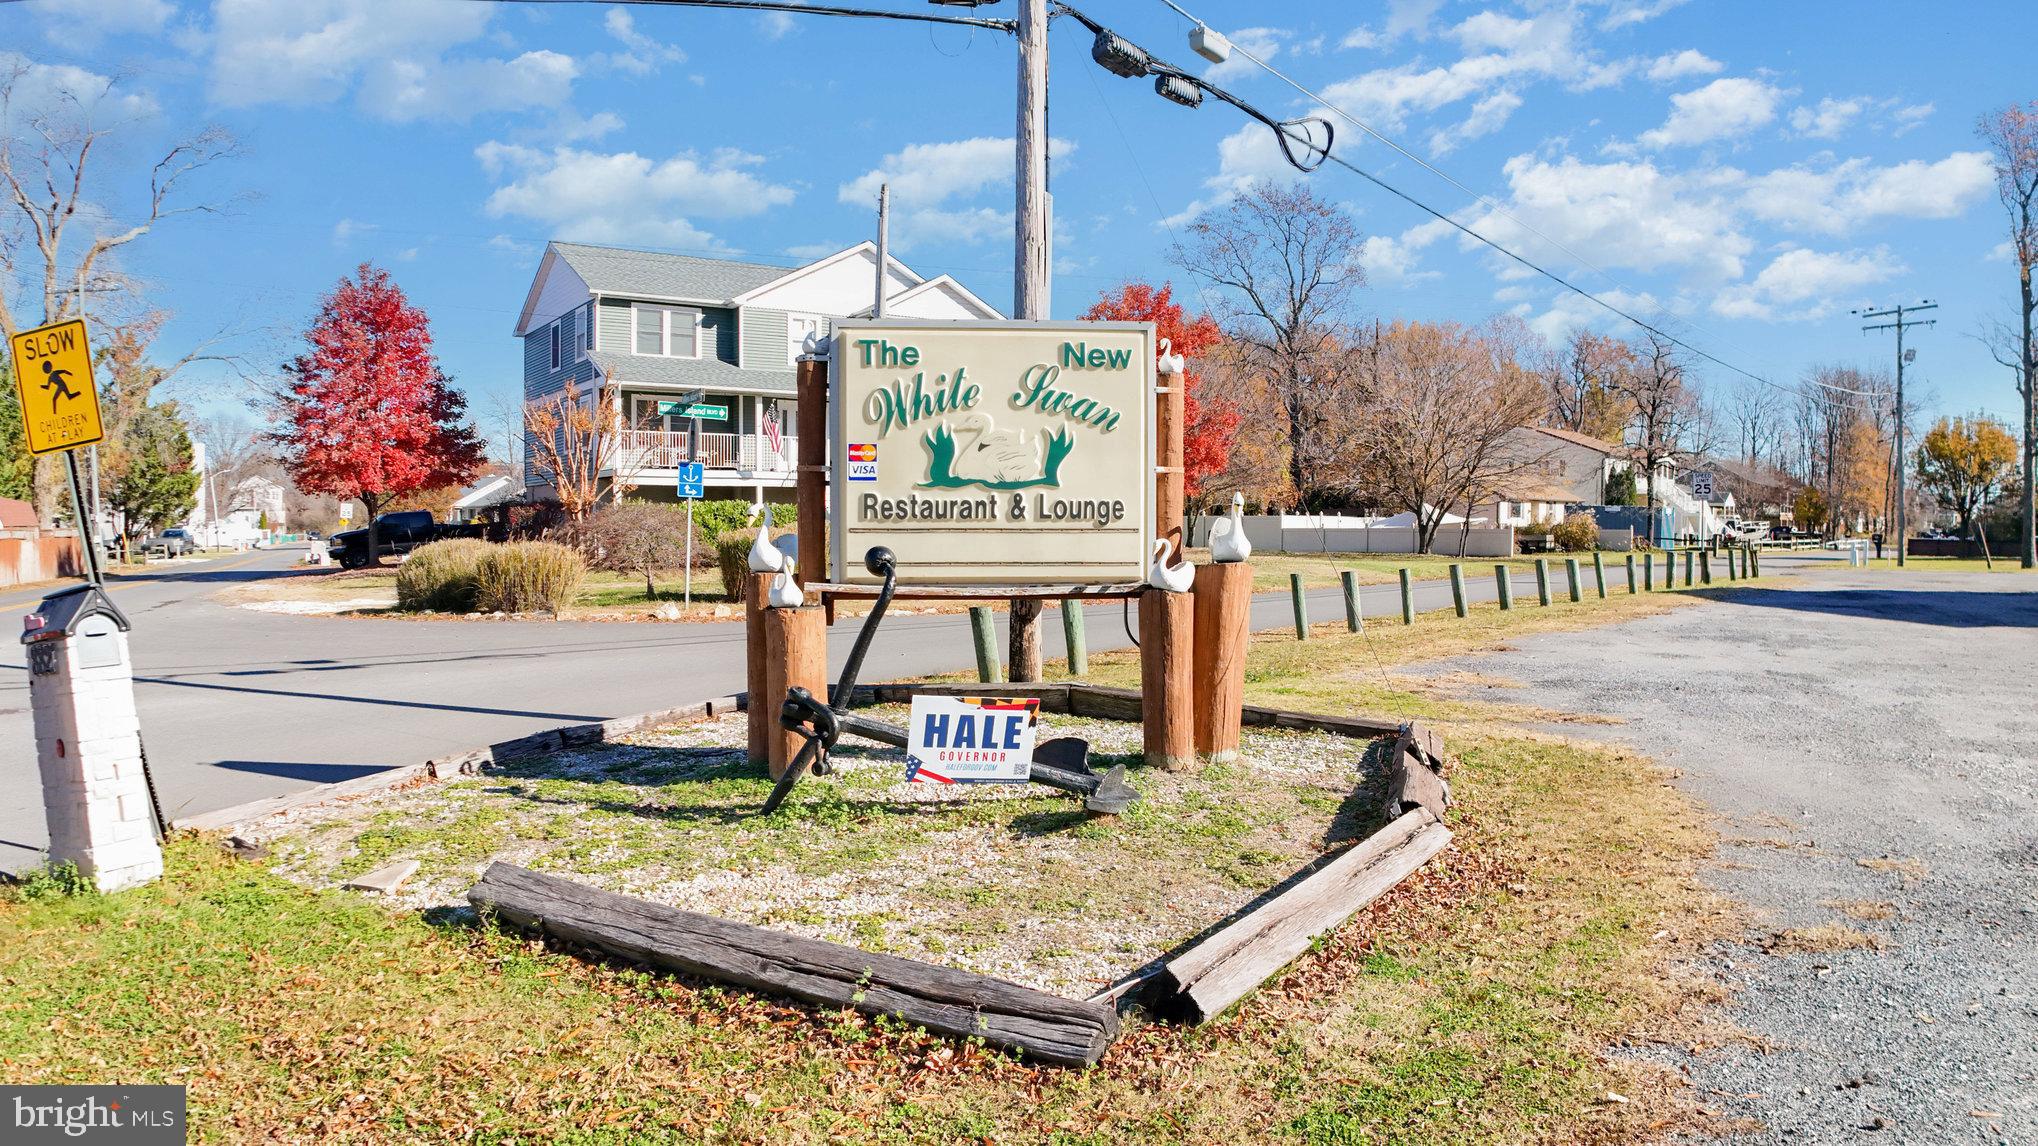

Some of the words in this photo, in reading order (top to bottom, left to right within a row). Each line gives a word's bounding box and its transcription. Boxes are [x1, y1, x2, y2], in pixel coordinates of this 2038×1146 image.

[25, 328, 74, 360] SLOW
[858, 339, 920, 366] The
[1064, 342, 1132, 369] New
[869, 366, 981, 437] White
[1013, 364, 1122, 433] Swan
[40, 413, 88, 433] CHILDREN
[48, 432, 57, 444] AT
[61, 427, 84, 440] PLAY
[852, 466, 875, 474] VISA
[1694, 484, 1711, 495] 25
[863, 493, 998, 520] Restaurant
[1010, 493, 1026, 520] &
[1039, 493, 1125, 526] Lounge
[923, 714, 1024, 750] HALE
[939, 751, 1007, 762] GOVERNOR
